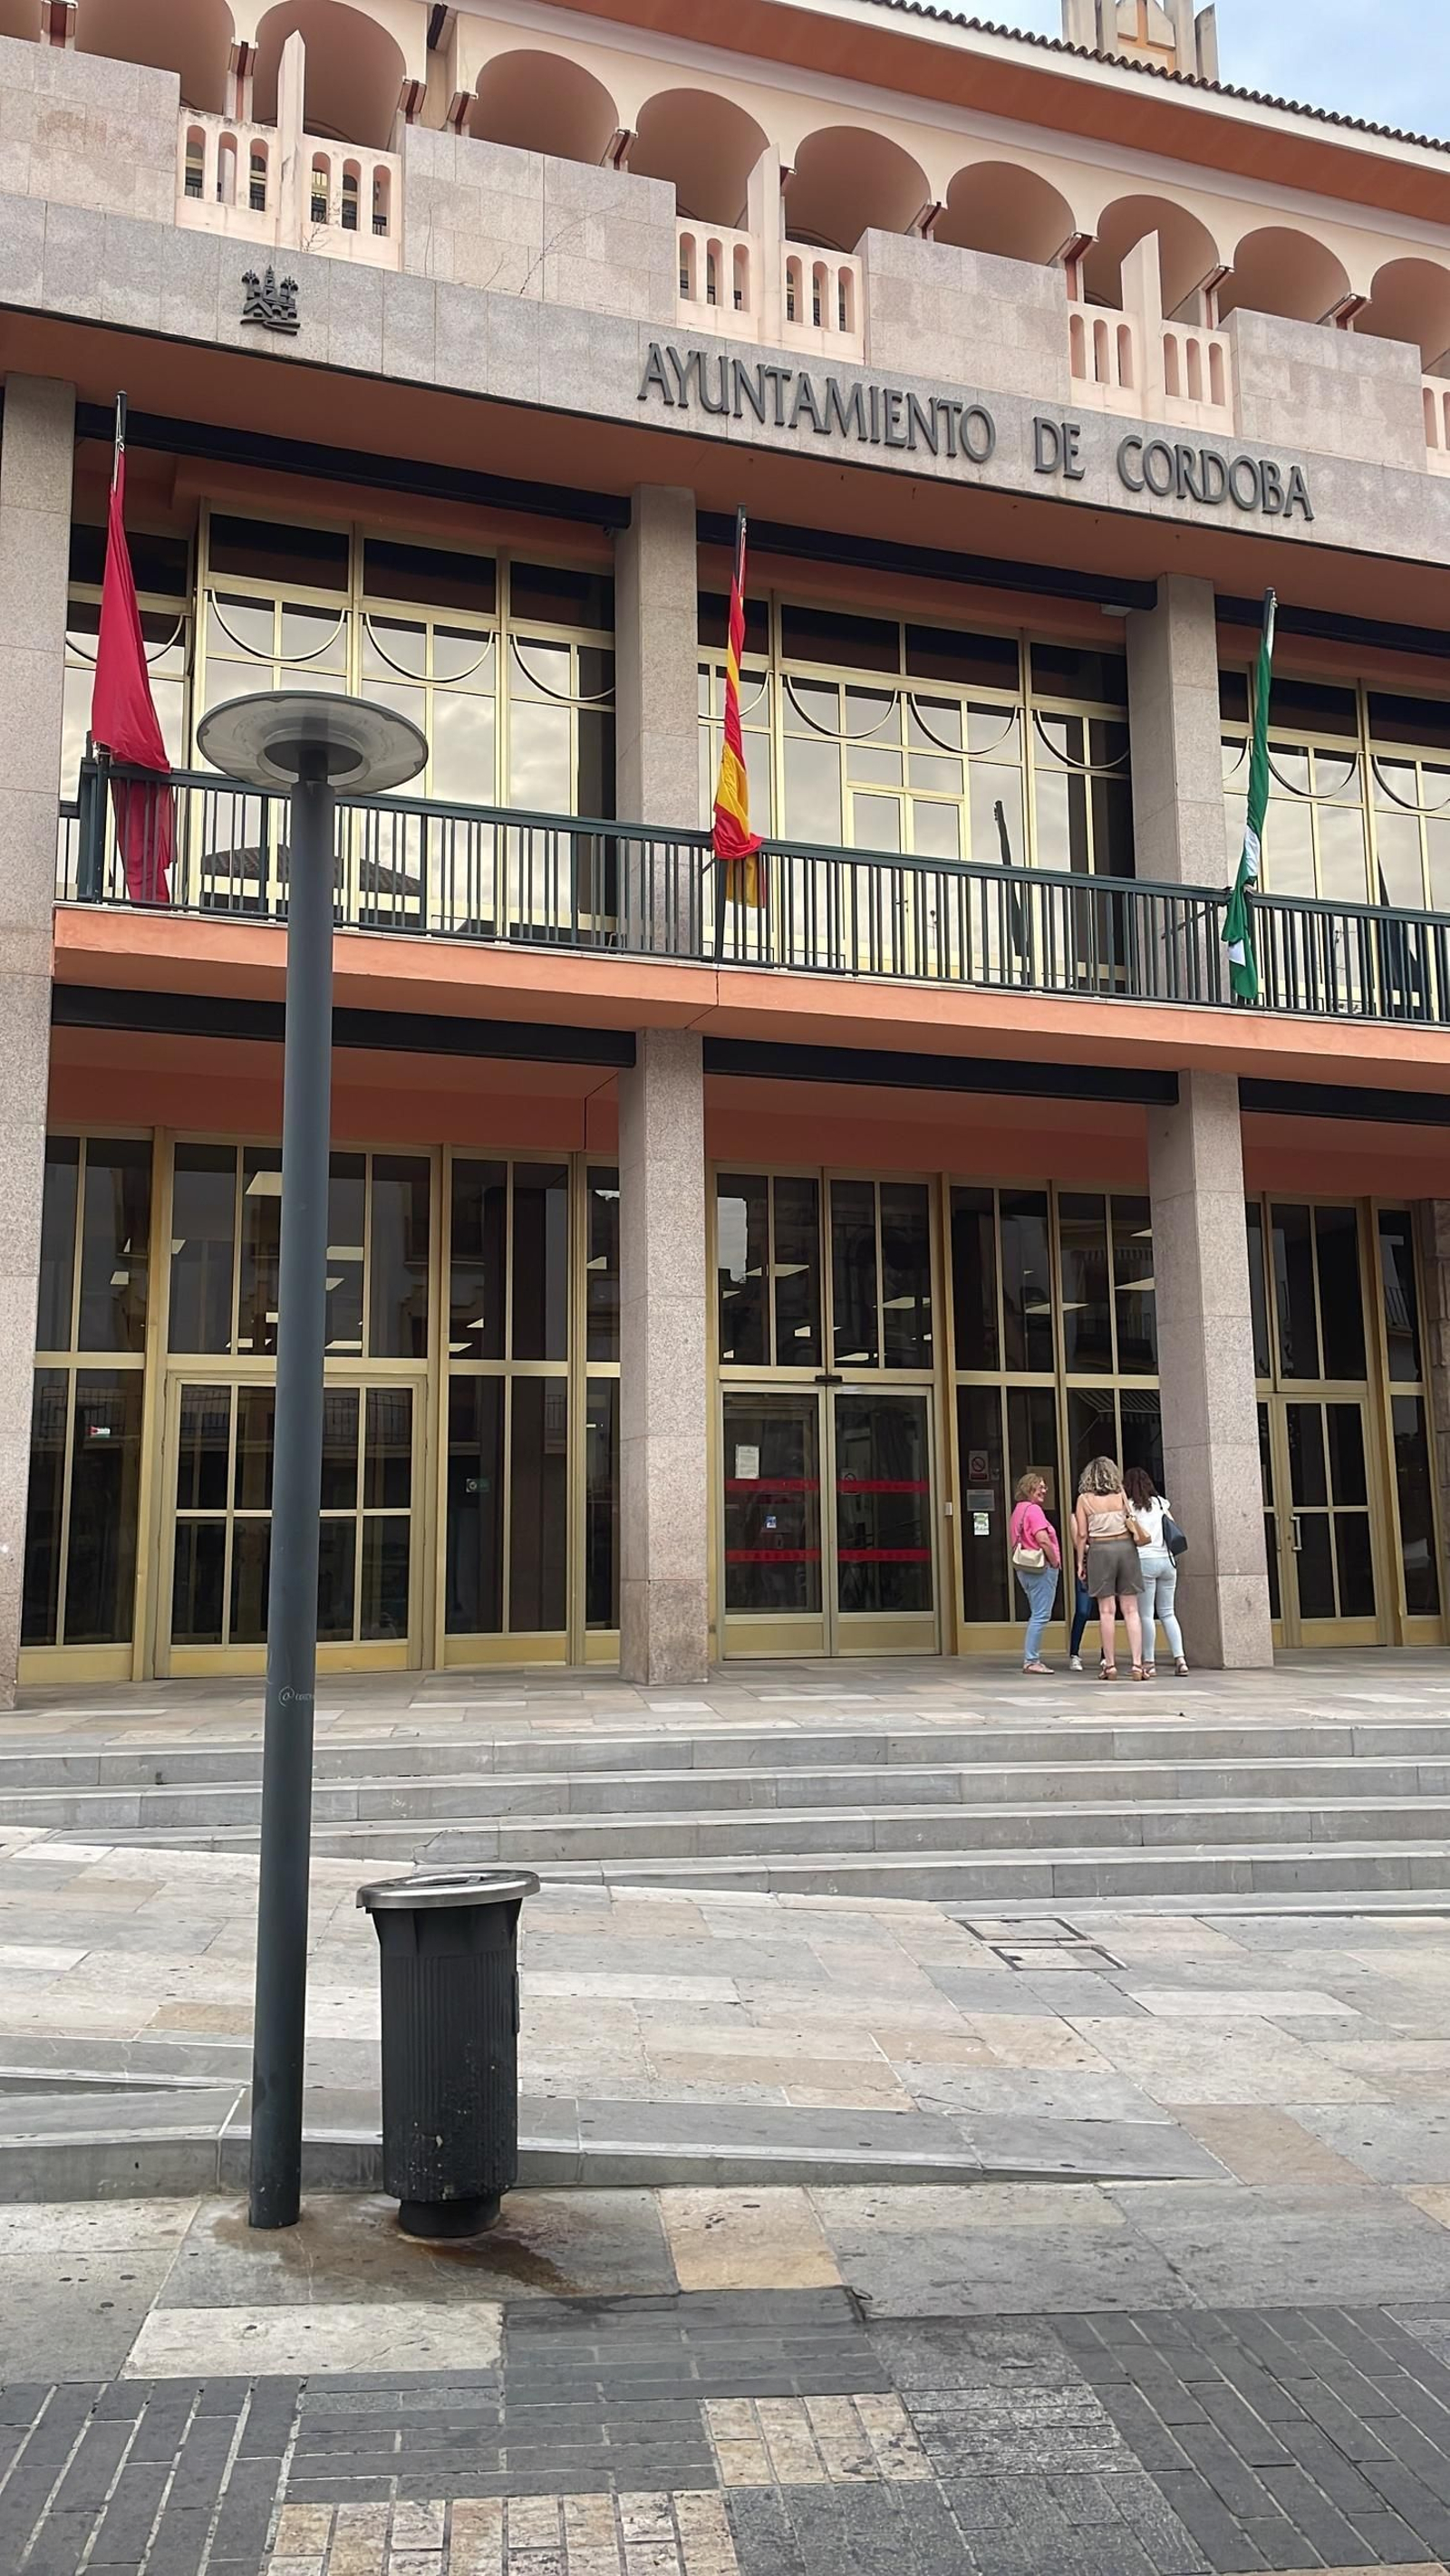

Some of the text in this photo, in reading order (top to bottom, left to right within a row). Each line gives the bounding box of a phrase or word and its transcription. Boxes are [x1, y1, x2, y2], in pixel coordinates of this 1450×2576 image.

[637, 343, 1314, 521] AYUNTAMIENTO DE CORDOBA
